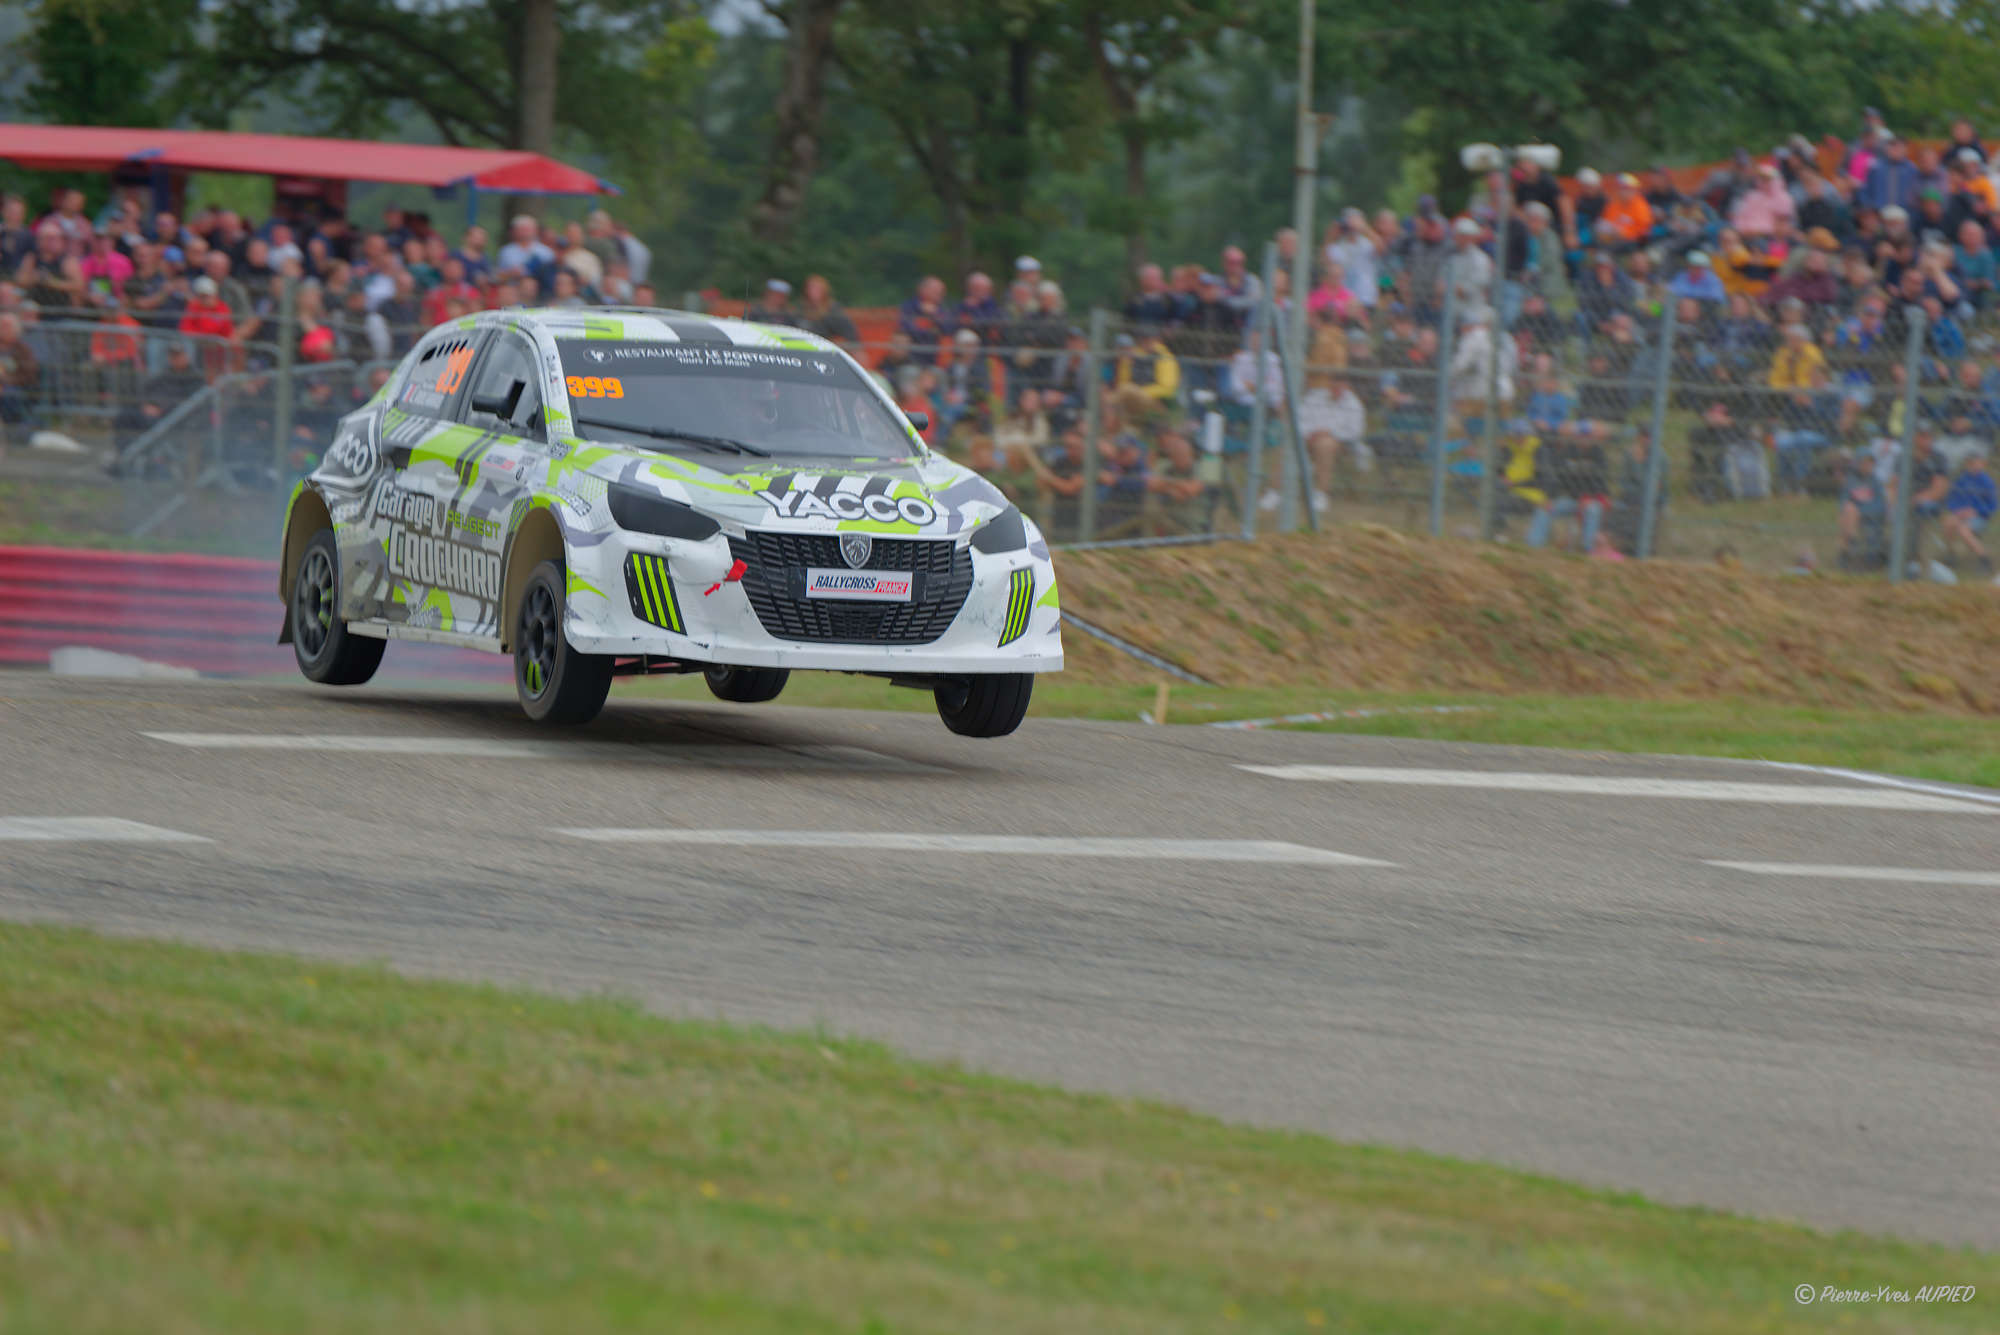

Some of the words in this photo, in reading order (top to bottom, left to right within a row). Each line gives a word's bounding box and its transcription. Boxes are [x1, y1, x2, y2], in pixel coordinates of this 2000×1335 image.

[614, 347, 700, 360] RESTAURANT
[705, 349, 720, 359] LE
[723, 350, 802, 368] PORTOFINO
[566, 375, 625, 399] 399
[376, 480, 434, 531] Garage
[753, 489, 937, 527] YACCO
[447, 509, 502, 540] PEUGEOT
[388, 521, 502, 602] CROCHARD
[815, 575, 877, 590] RALLYCROSS
[877, 582, 908, 595] FRANCE
